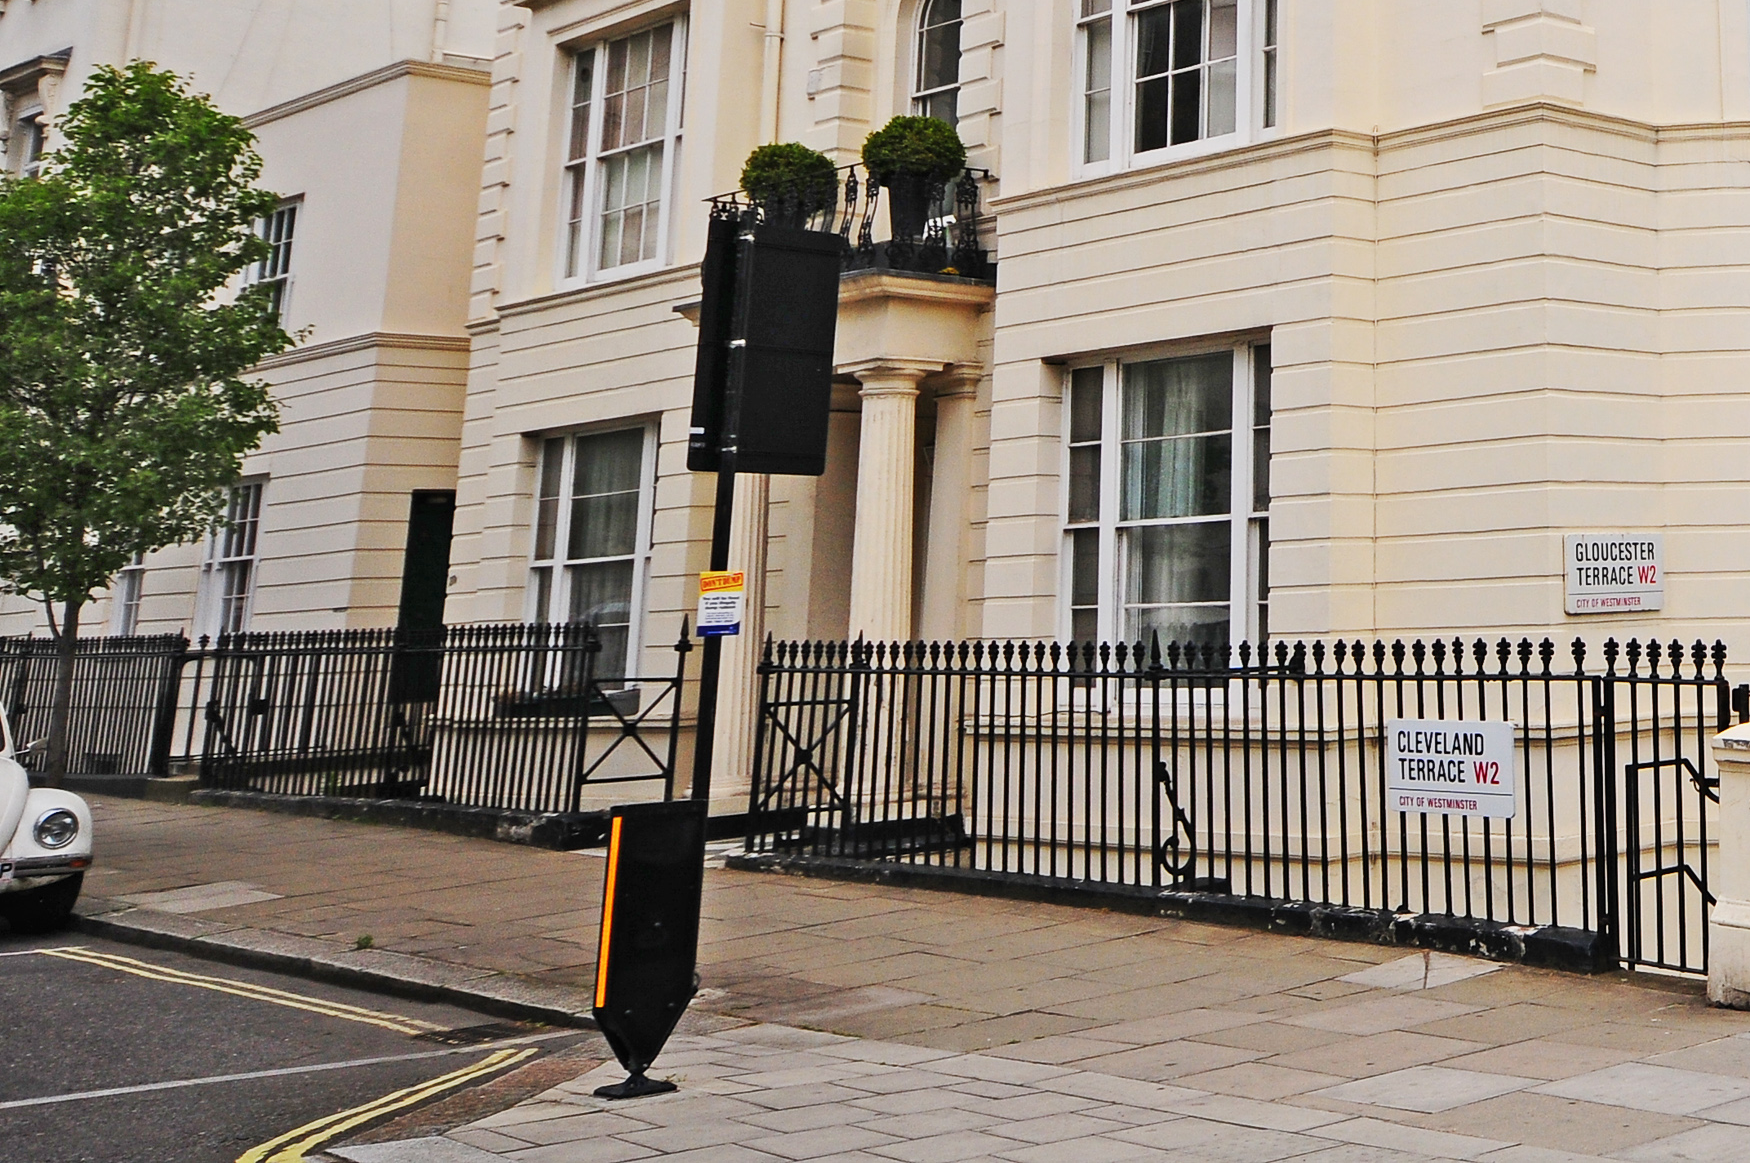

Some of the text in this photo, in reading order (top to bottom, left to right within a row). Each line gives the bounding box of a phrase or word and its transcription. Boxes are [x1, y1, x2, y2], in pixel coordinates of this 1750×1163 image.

[1575, 542, 1655, 562] GLOUCESTER
[1576, 565, 1657, 586] TERRACE W2
[1576, 597, 1641, 608] CITY OF WESTMINSTER
[1397, 730, 1485, 756] CLEVELAND
[1398, 758, 1500, 785] TERRACE W2
[1399, 795, 1478, 810] CITY OF WESTMINSTER
